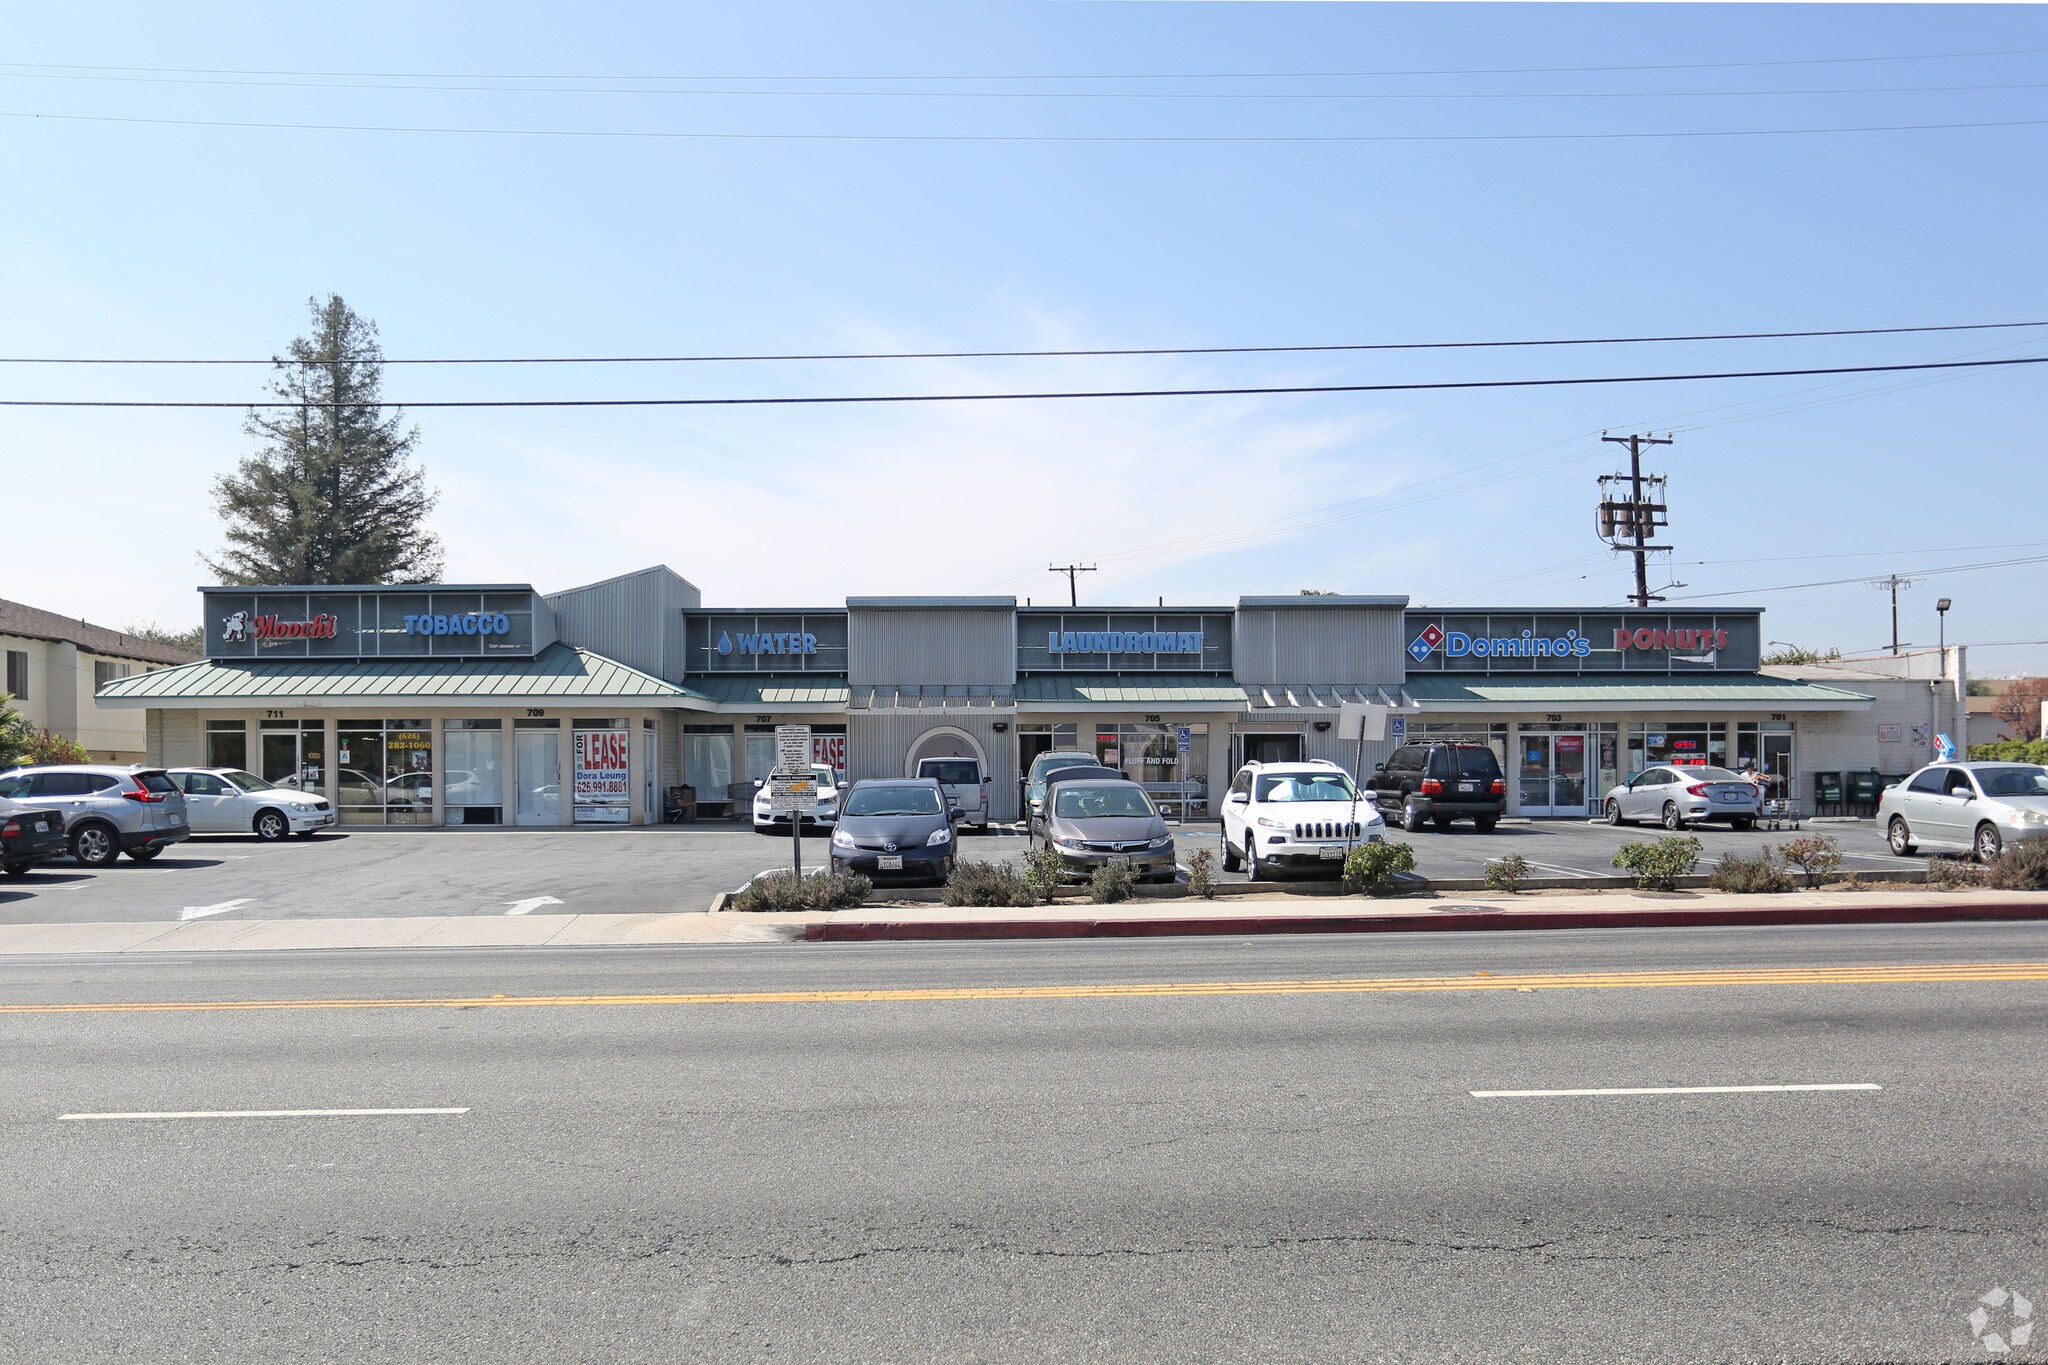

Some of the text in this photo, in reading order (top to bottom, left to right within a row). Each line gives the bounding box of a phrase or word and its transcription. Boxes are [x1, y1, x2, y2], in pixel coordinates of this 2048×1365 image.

[251, 613, 337, 638] Moochi
[404, 613, 510, 636] TOBACCO
[736, 632, 817, 654] WATER
[1049, 632, 1203, 653] LAUNDROMAT
[1446, 629, 1591, 657] Domino's
[1613, 628, 1728, 650] DONUTS
[267, 710, 284, 718] 711
[527, 709, 544, 717] 709
[388, 742, 431, 750] 282-1060
[398, 732, 420, 741] (626)
[584, 733, 627, 770] LEASE
[813, 738, 844, 769] EASE
[577, 772, 598, 780] Dora
[600, 772, 626, 781] Leung
